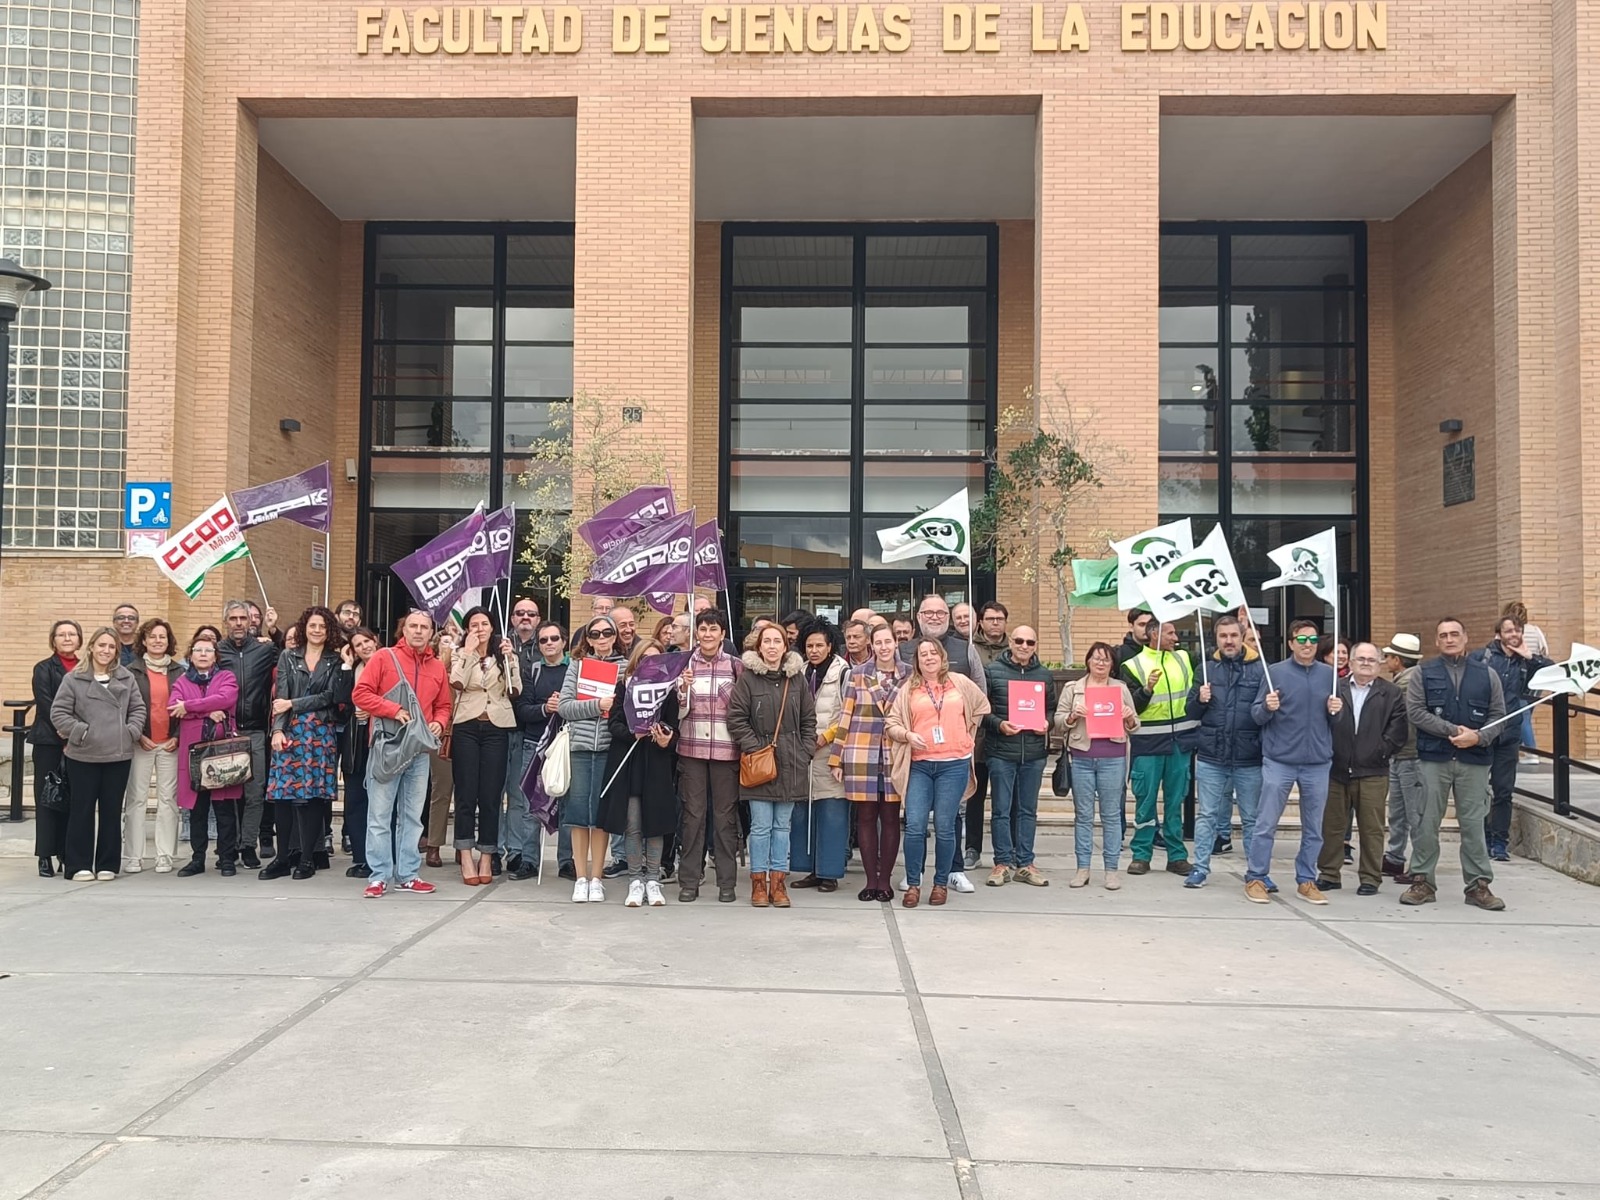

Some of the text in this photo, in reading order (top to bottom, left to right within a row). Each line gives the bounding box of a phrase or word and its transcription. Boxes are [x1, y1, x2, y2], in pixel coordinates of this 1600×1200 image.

[356, 2, 1388, 55] FACULTAD DE CIENCIAS DE LA EDUCACION
[130, 488, 156, 524] P
[162, 507, 235, 571] CCOO
